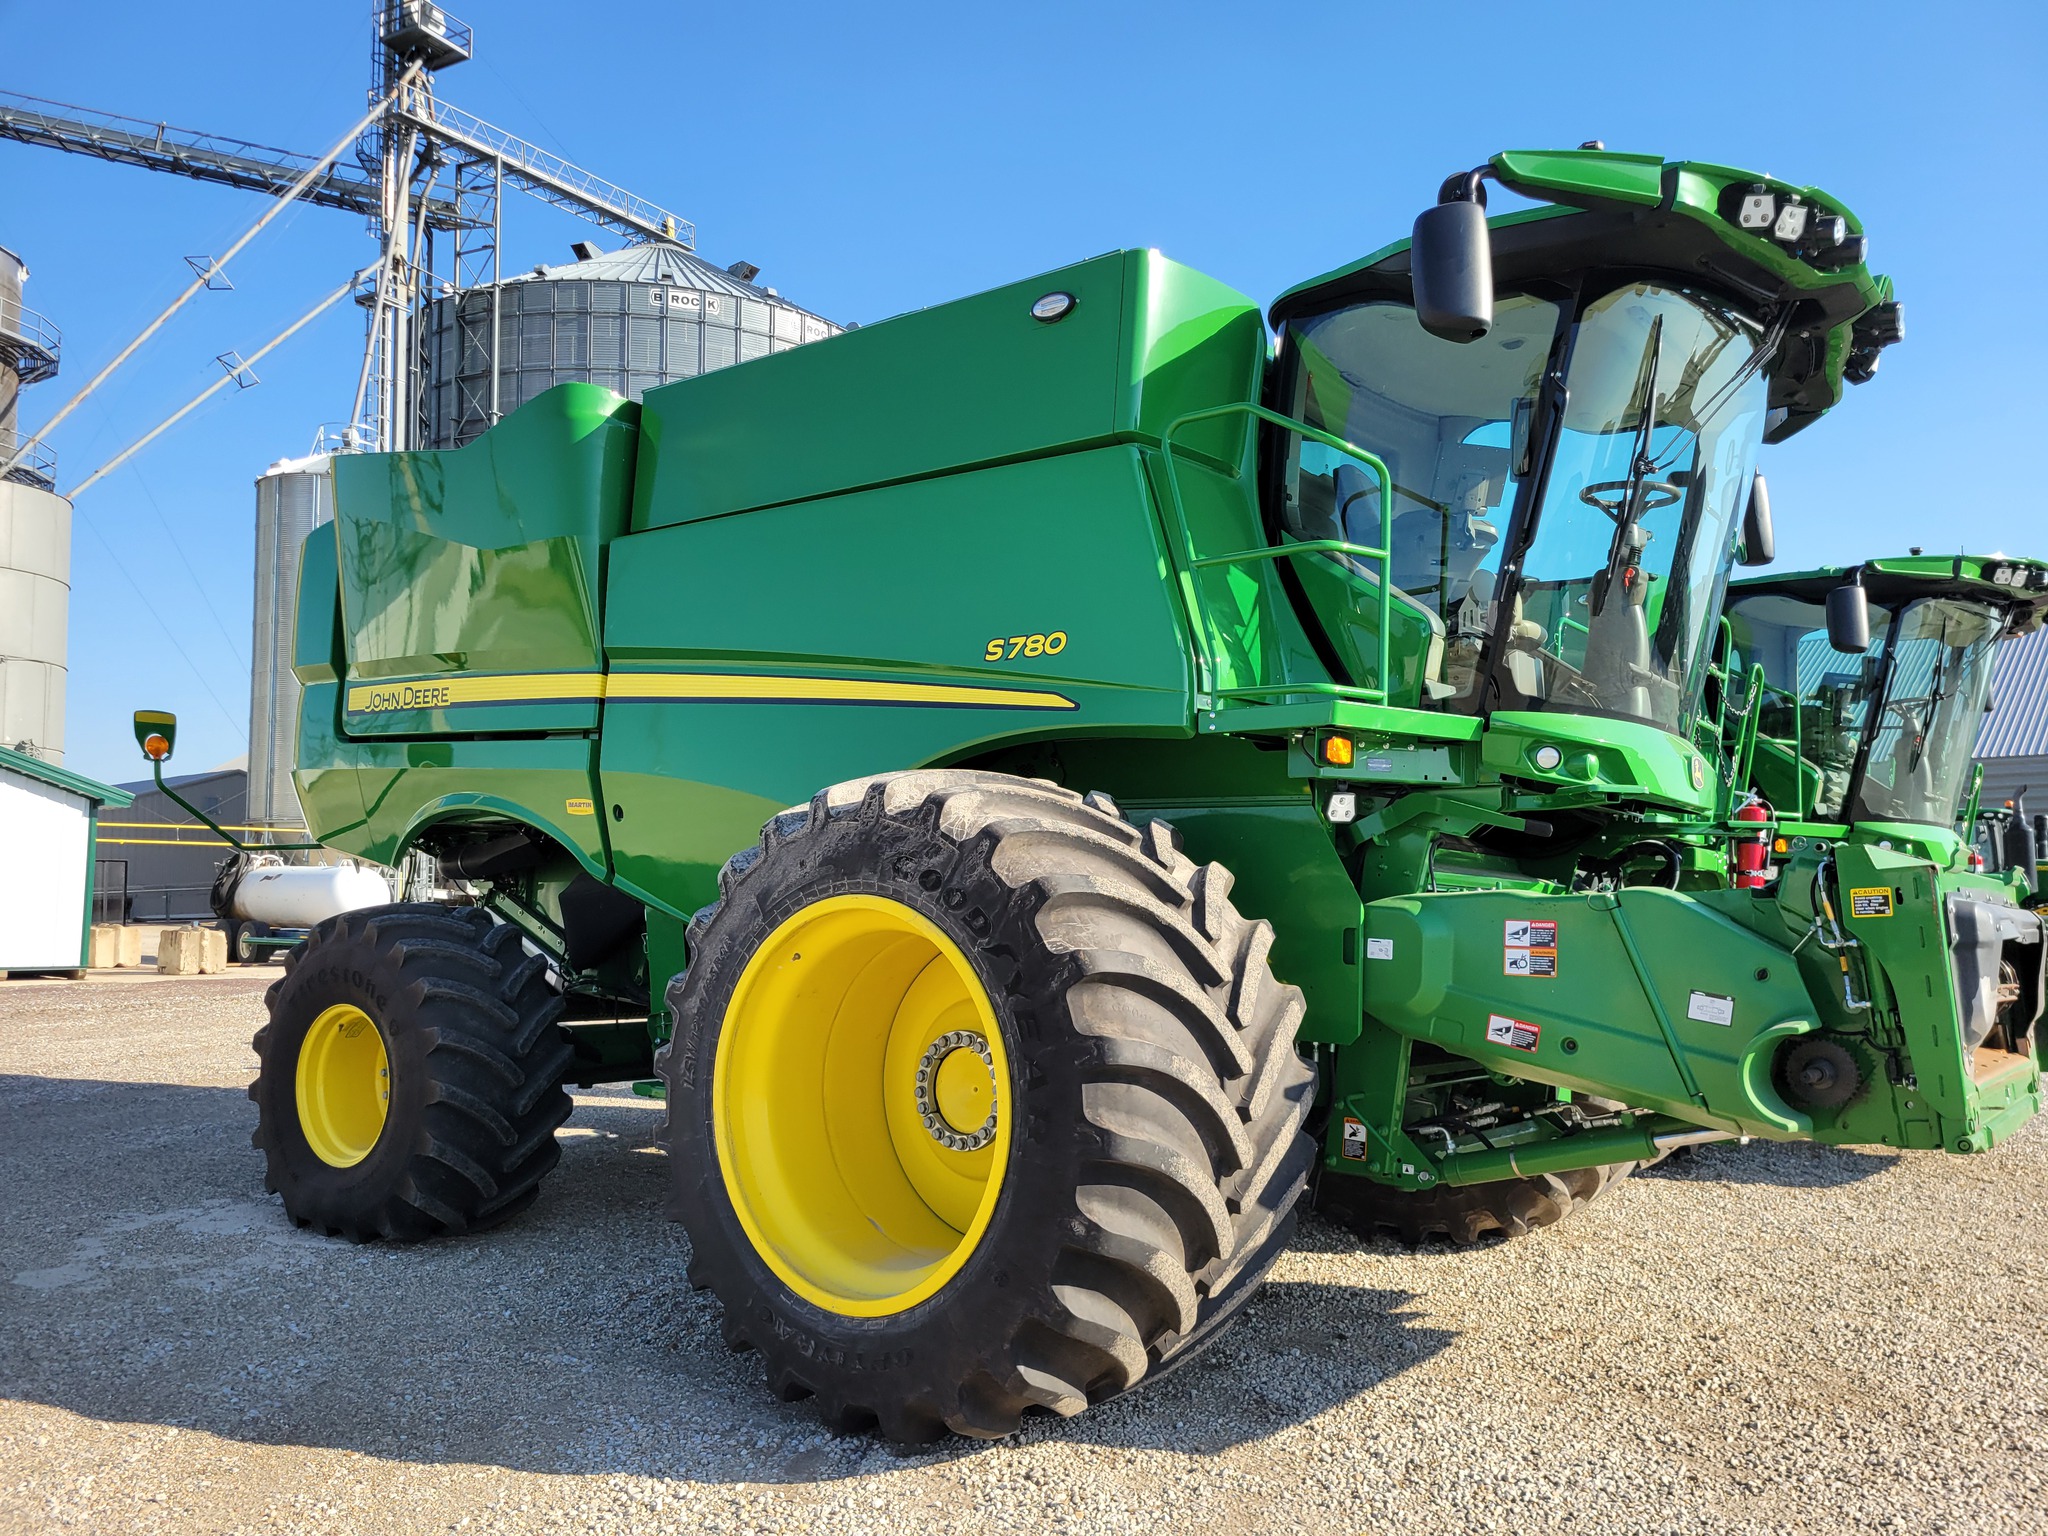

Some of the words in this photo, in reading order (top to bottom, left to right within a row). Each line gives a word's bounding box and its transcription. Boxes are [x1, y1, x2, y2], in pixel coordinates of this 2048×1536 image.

[653, 292, 716, 310] BROCK
[984, 630, 1068, 662] S780
[365, 690, 401, 710] JOHN
[403, 686, 450, 706] DEERE
[1518, 1023, 1539, 1031] DANGER
